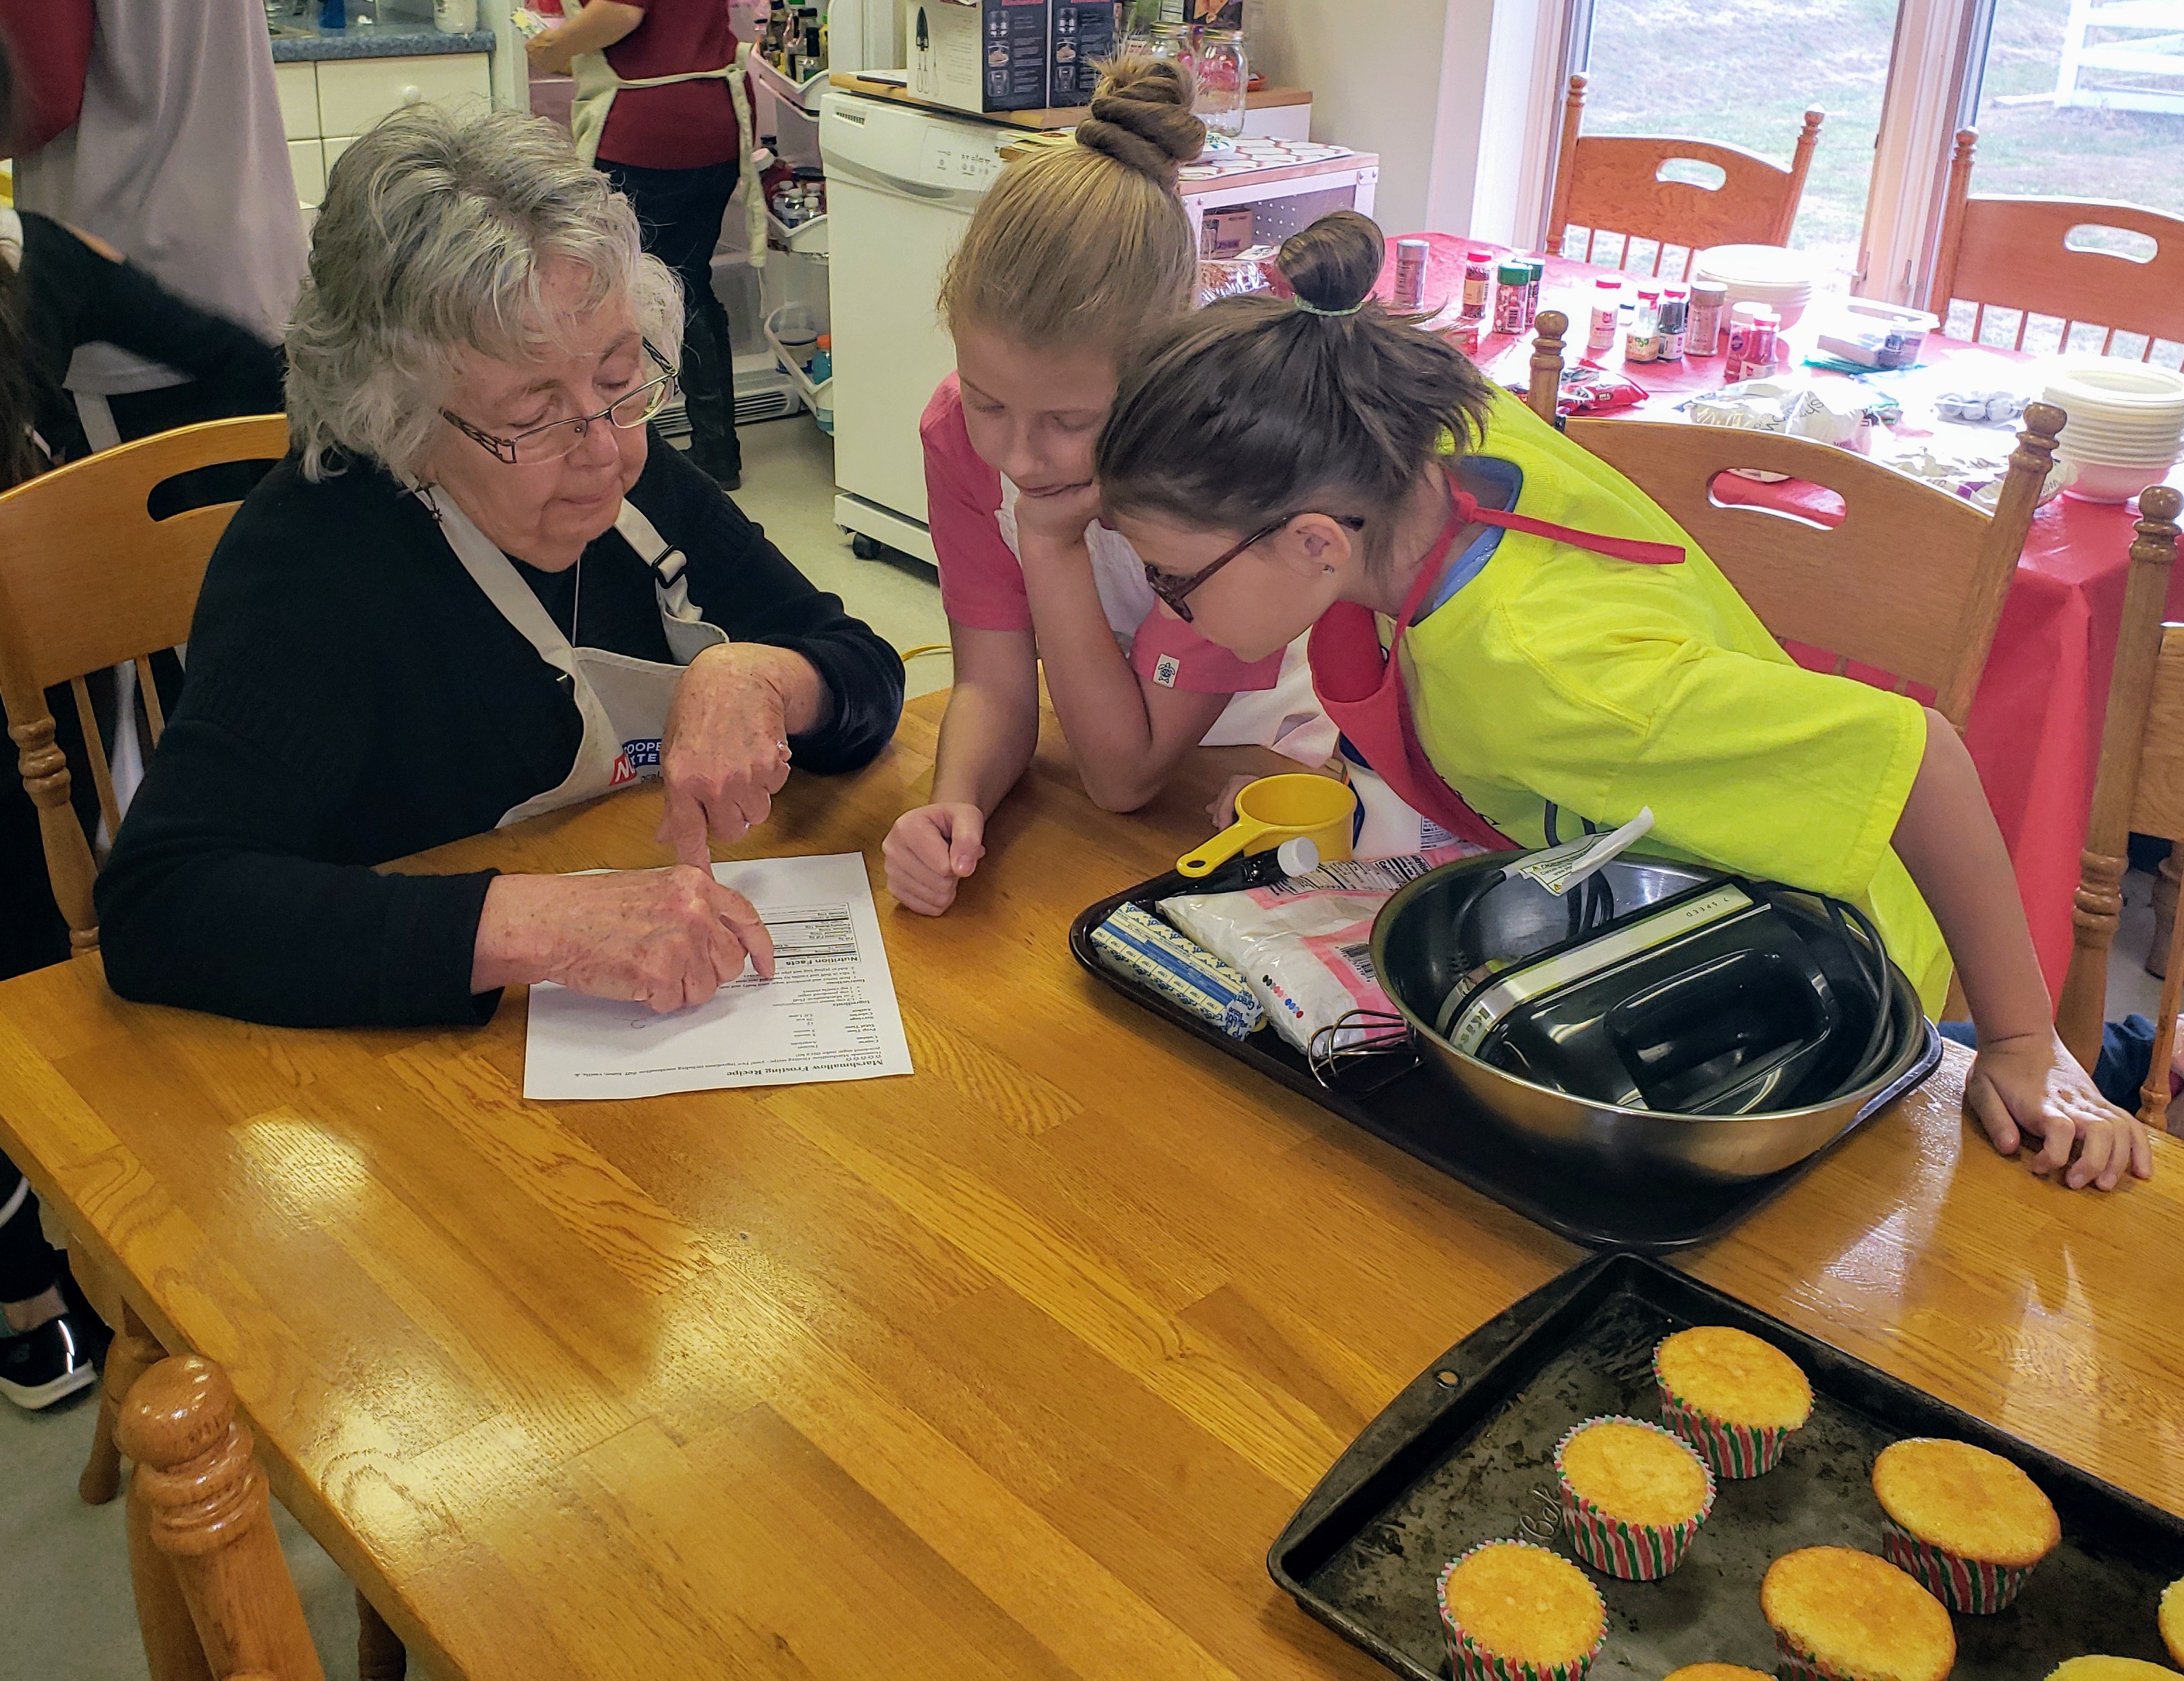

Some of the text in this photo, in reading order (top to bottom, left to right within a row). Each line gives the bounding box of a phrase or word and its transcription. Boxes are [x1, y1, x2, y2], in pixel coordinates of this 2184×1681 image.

[624, 742, 662, 754] OOPE
[1686, 902, 1718, 917] SPEED
[1234, 995, 1254, 1010] Great
[812, 1060, 883, 1070] Marshmallow
